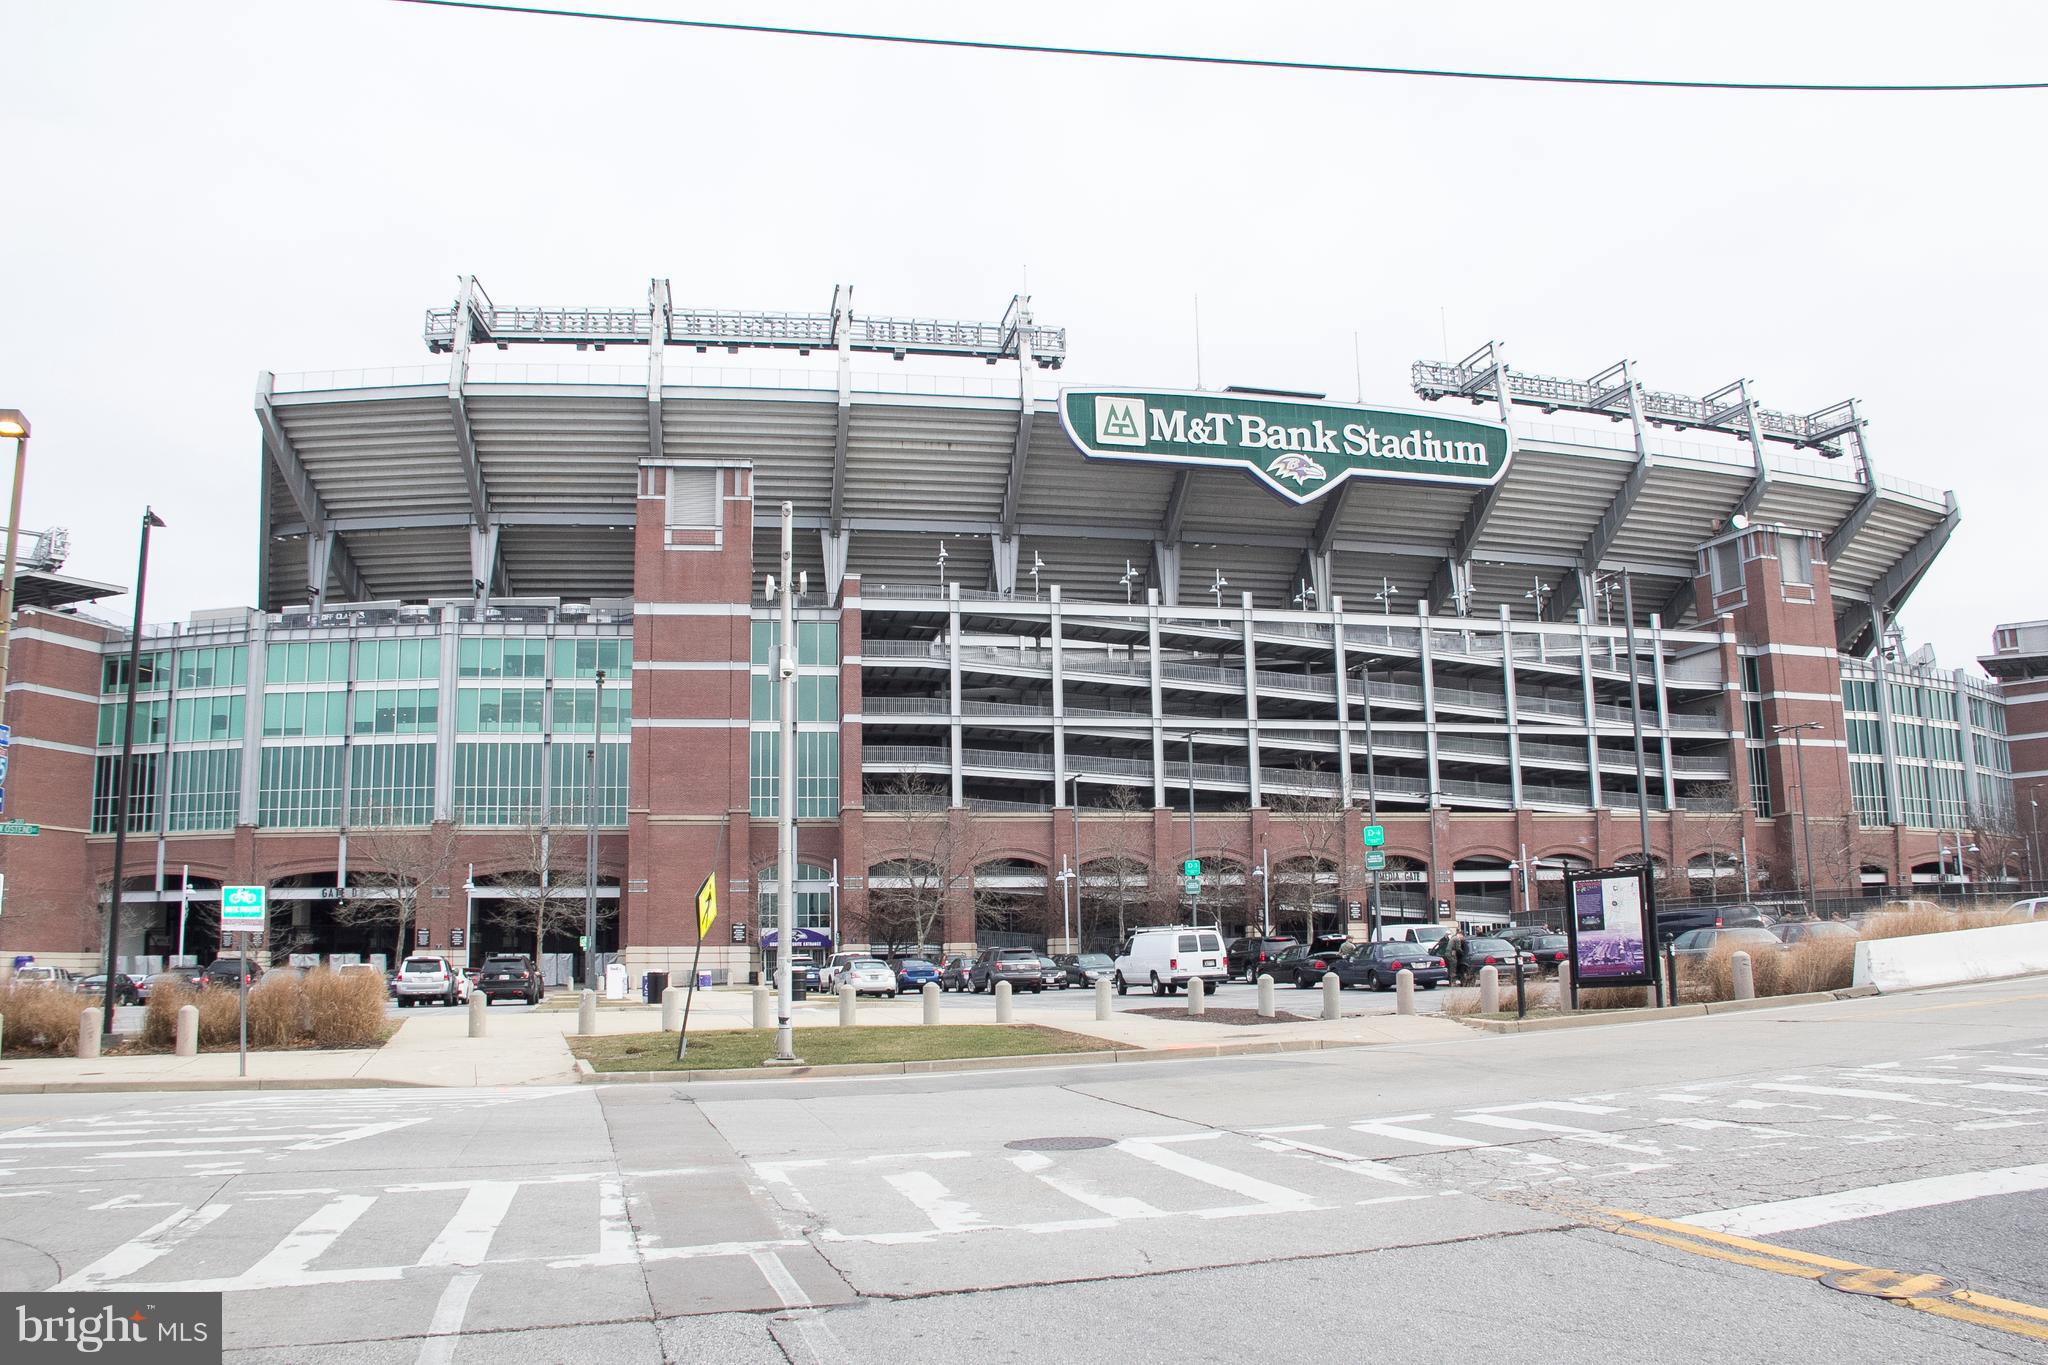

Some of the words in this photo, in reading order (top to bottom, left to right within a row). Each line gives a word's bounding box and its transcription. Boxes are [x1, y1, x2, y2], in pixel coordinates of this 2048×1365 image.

[1150, 408, 1234, 446] M&T
[1238, 414, 1340, 454] Bank
[1343, 423, 1489, 466] Stadium
[1404, 871, 1421, 881] GATE
